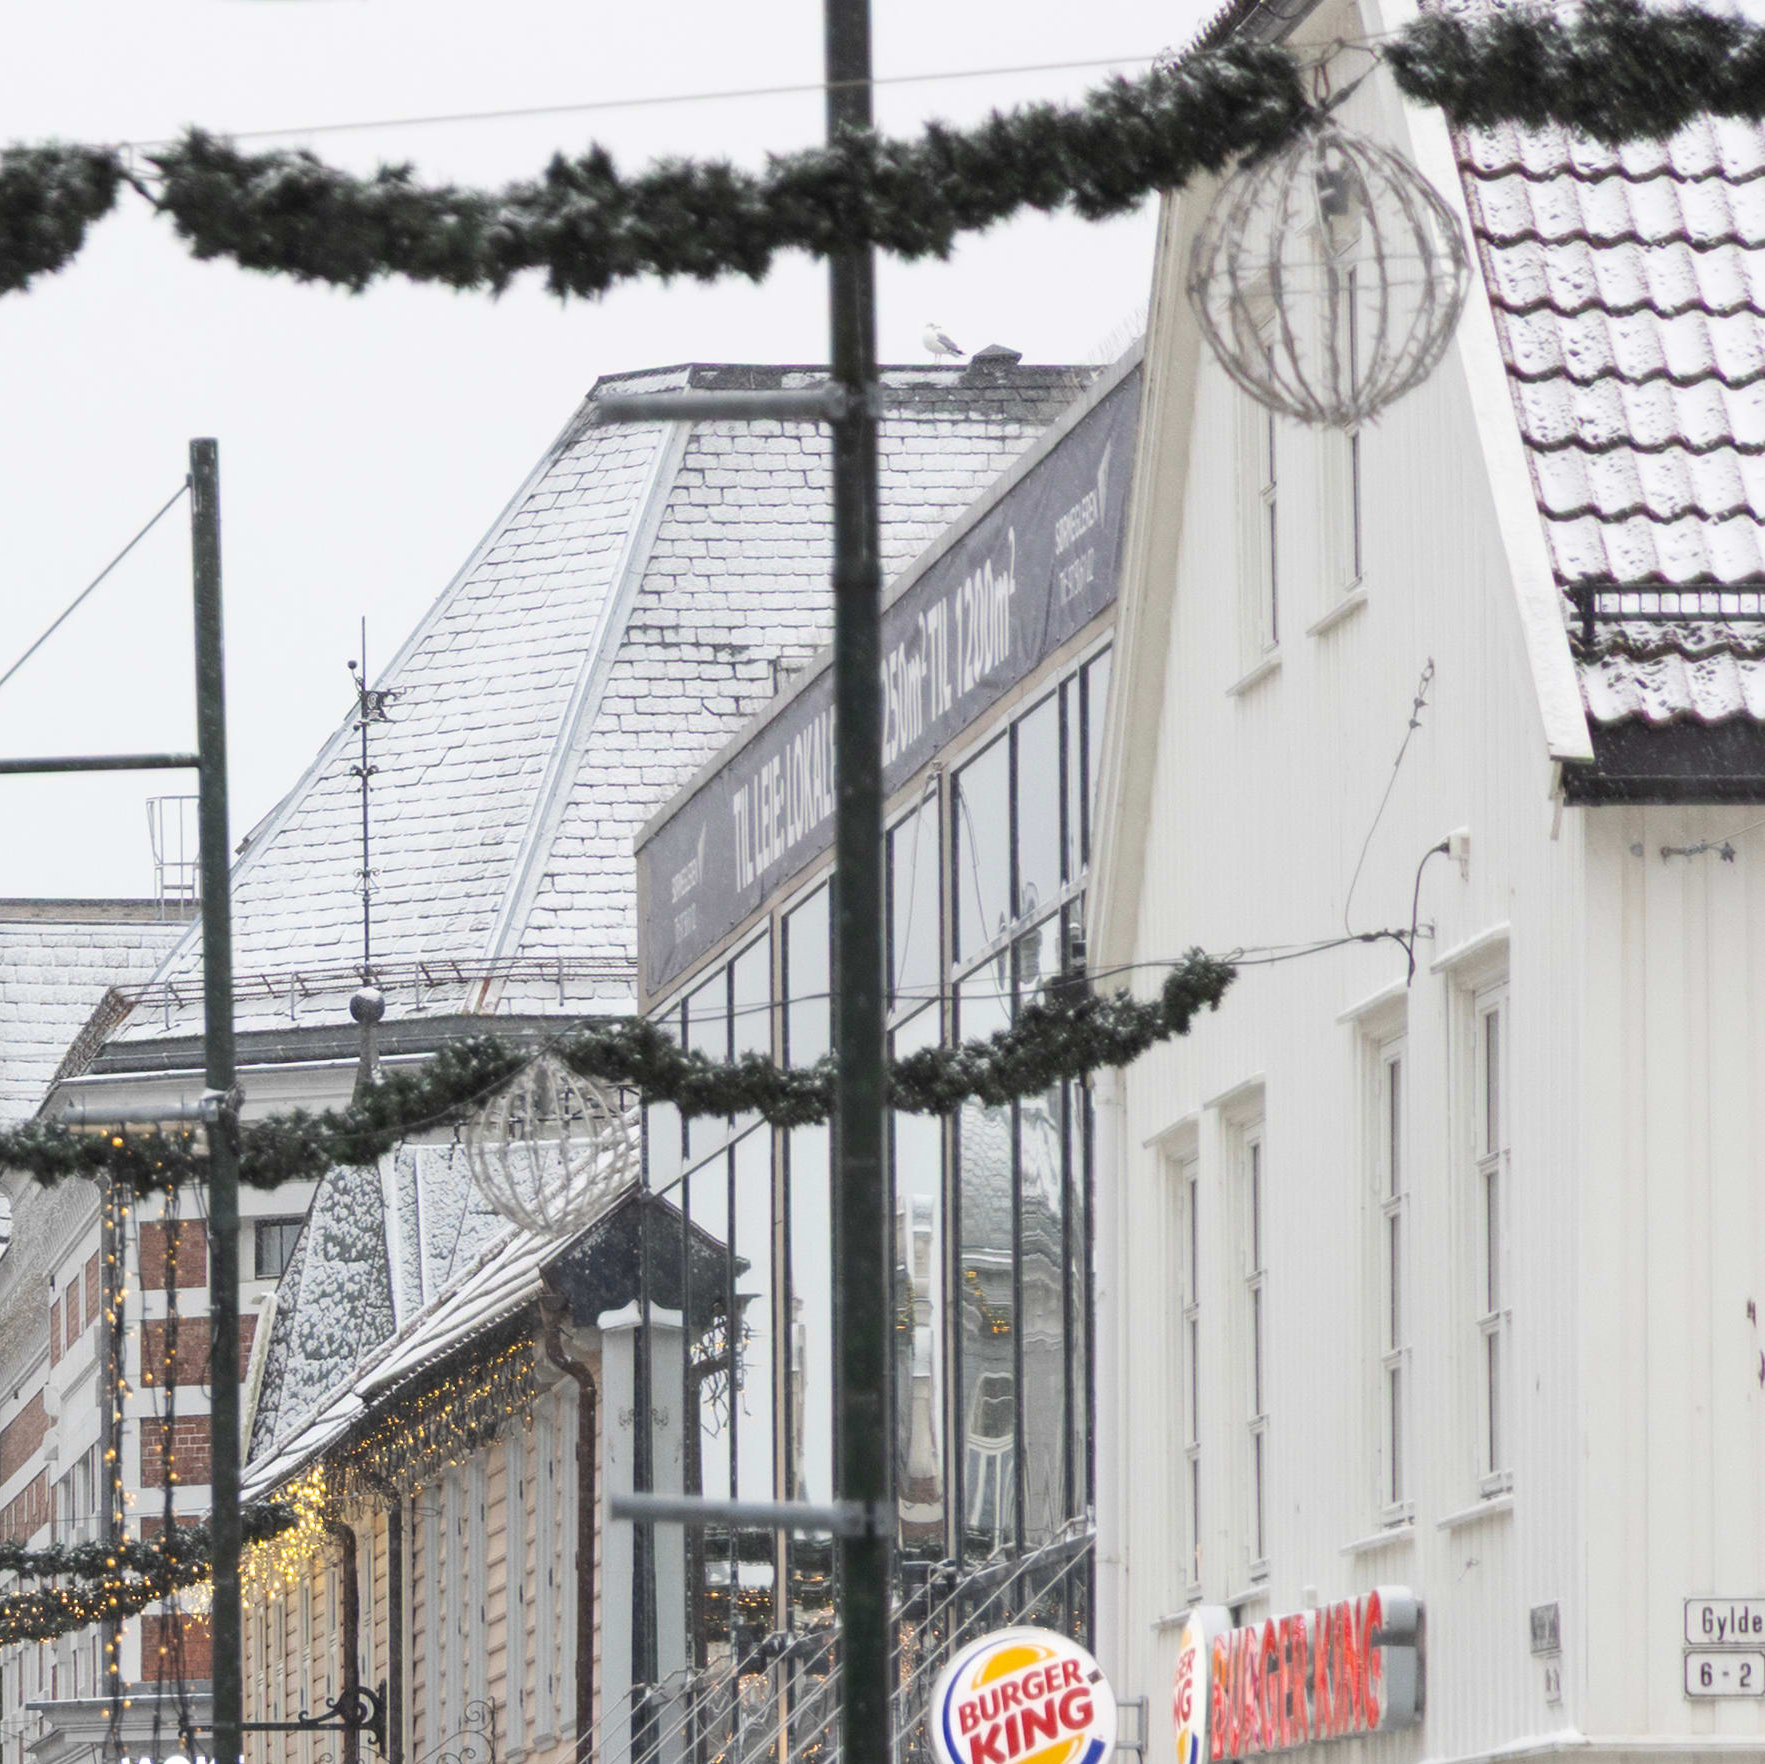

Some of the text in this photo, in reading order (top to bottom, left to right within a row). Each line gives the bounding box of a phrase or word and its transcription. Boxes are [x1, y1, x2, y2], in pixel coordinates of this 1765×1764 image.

[927, 597, 952, 722] TIL
[733, 783, 754, 893] TIL
[958, 1658, 1084, 1736] BURGER
[1212, 1589, 1383, 1762] BURGER KING
